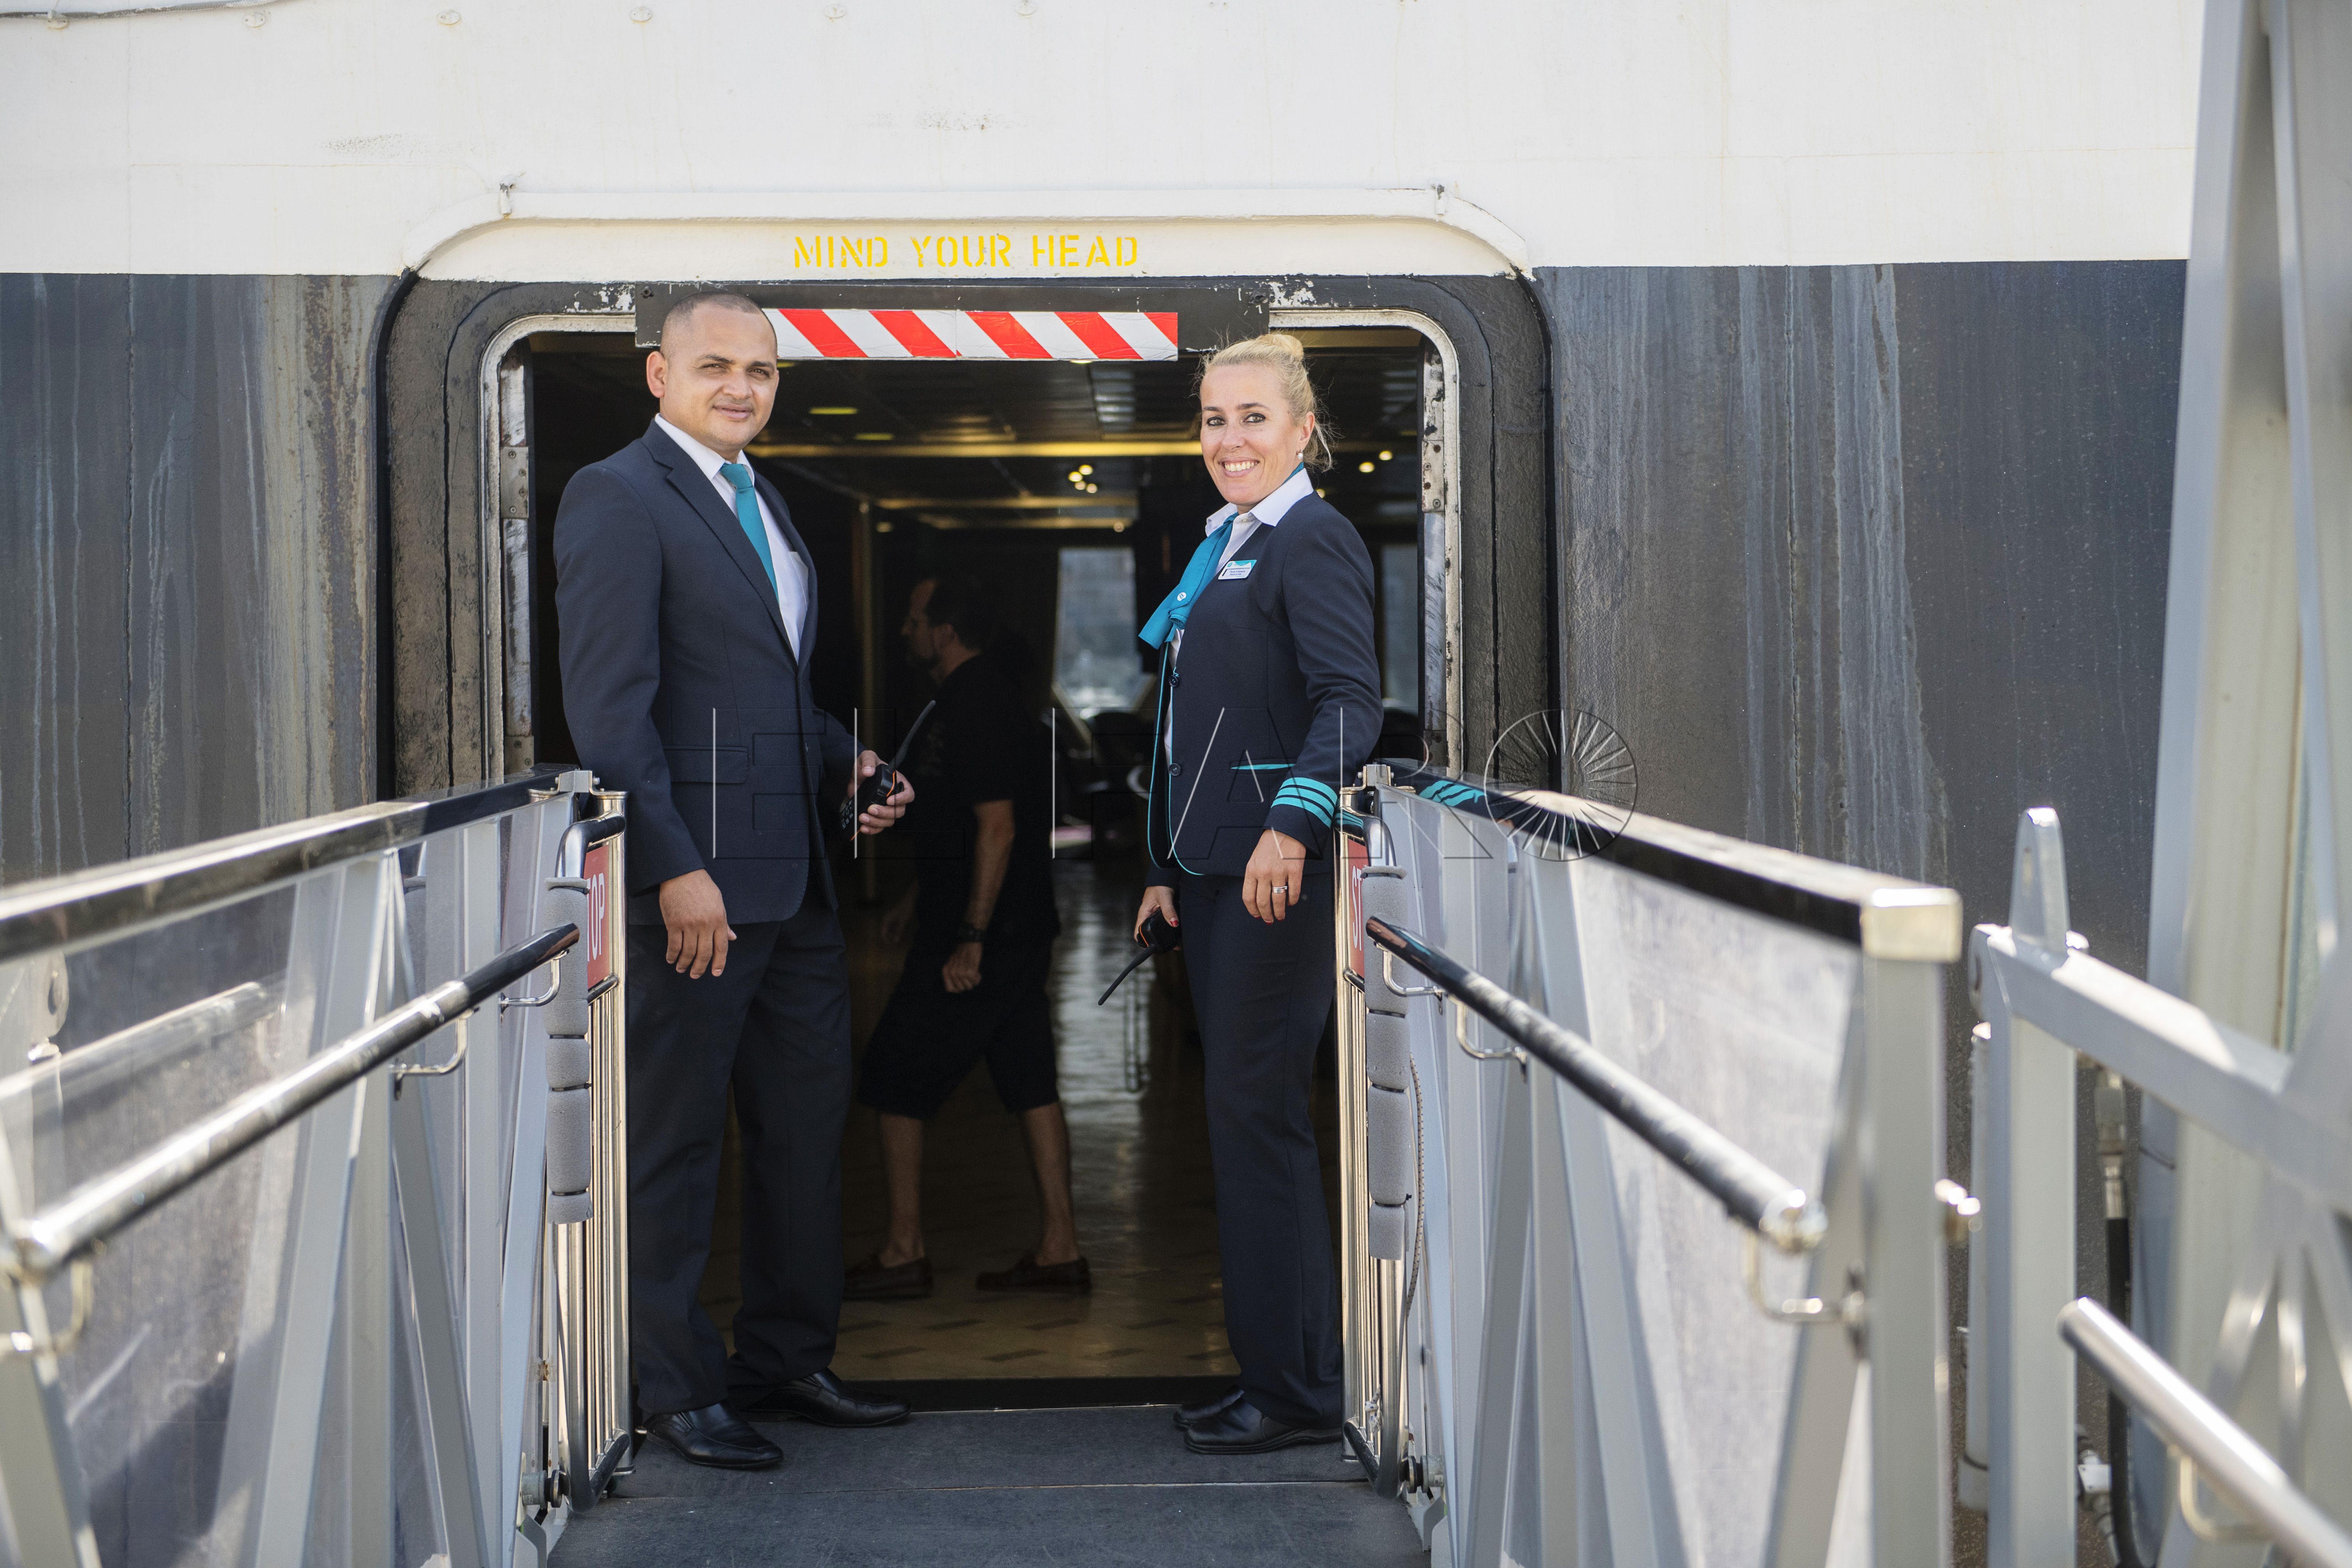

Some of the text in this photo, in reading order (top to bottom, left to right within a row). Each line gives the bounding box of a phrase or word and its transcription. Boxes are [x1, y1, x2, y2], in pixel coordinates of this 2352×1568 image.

[795, 235, 1138, 268] MIND YOUR HEAD
[587, 873, 605, 961] TOP
[1352, 865, 1363, 951] ST
